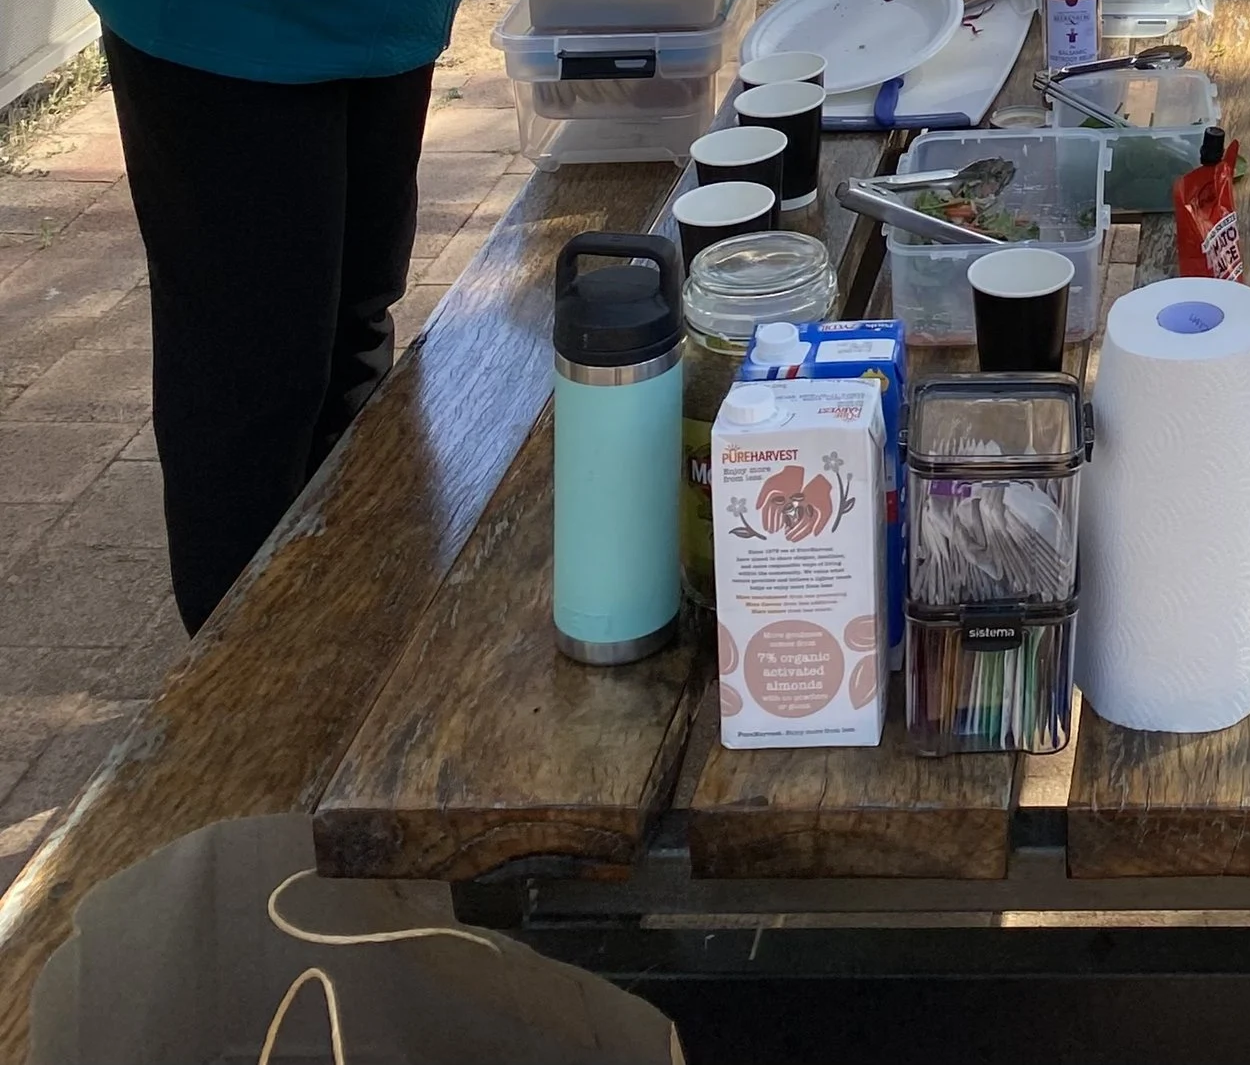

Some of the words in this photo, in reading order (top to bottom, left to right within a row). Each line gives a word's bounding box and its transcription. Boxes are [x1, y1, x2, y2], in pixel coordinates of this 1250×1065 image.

[722, 448, 798, 464] PUREHARVEST
[723, 468, 748, 476] Enjoy
[968, 627, 1015, 638] sistema
[757, 652, 778, 664] 7%
[780, 652, 830, 665] organic
[762, 665, 824, 677] activated
[766, 680, 824, 691] almonds
